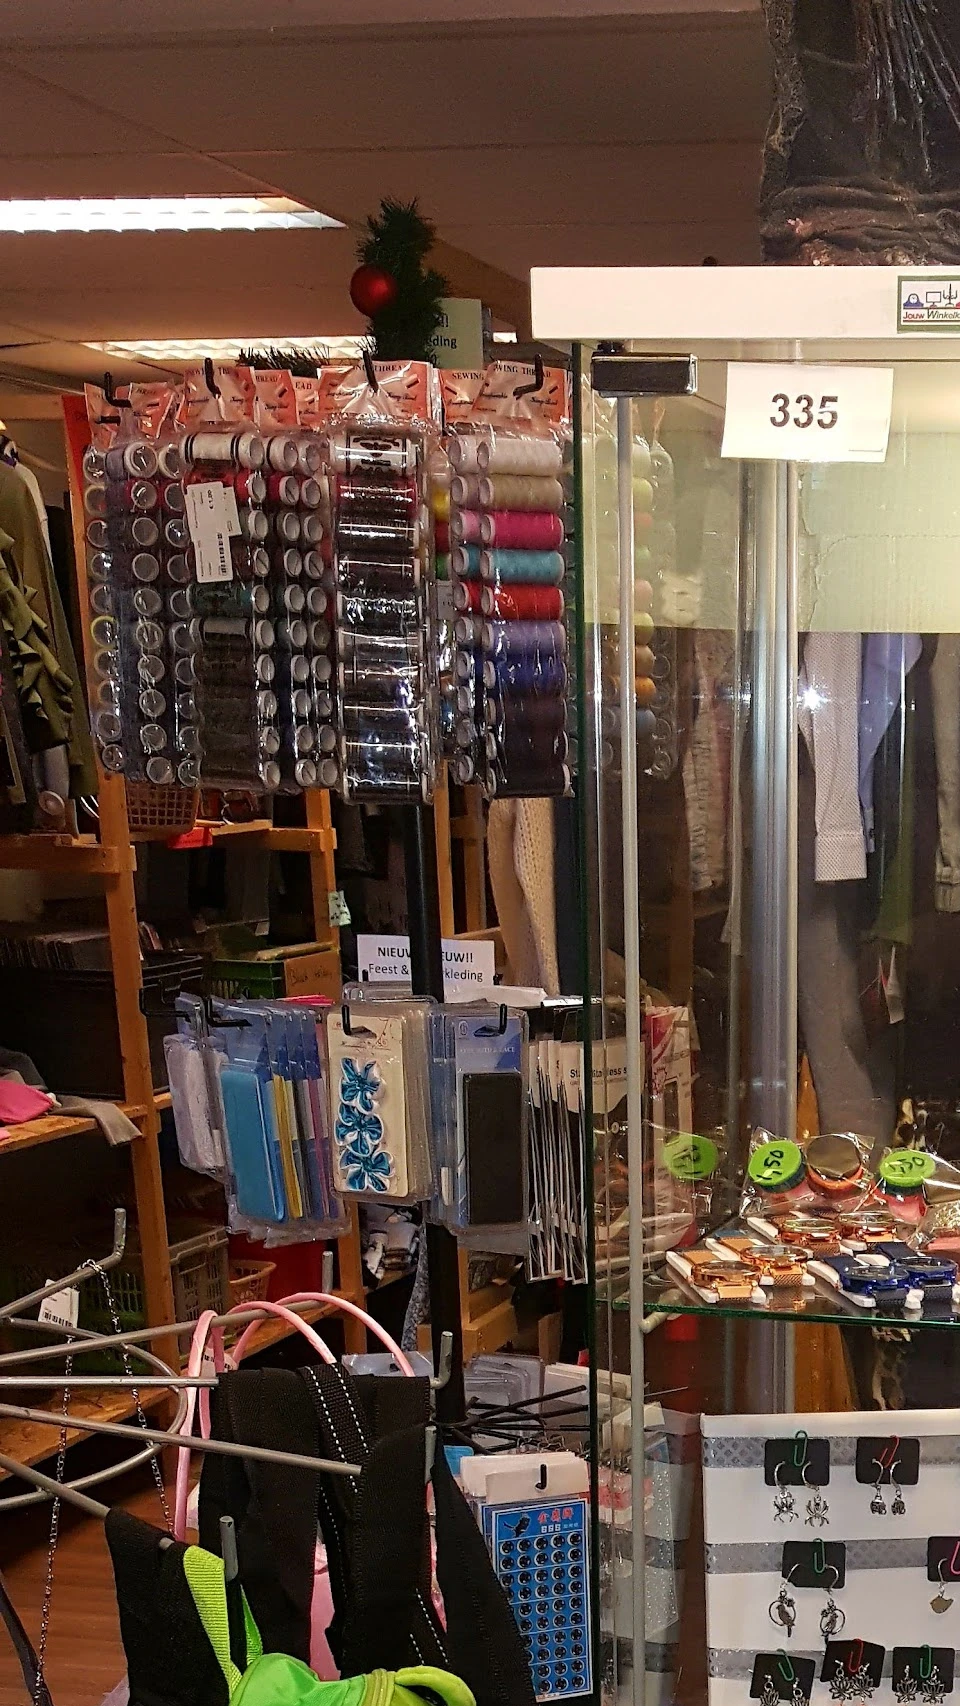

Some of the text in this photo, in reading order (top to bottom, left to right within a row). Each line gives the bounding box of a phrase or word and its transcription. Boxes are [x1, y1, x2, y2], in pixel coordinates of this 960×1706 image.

[770, 392, 839, 430] 335
[368, 963, 398, 975] Feest
[400, 964, 410, 975] &
